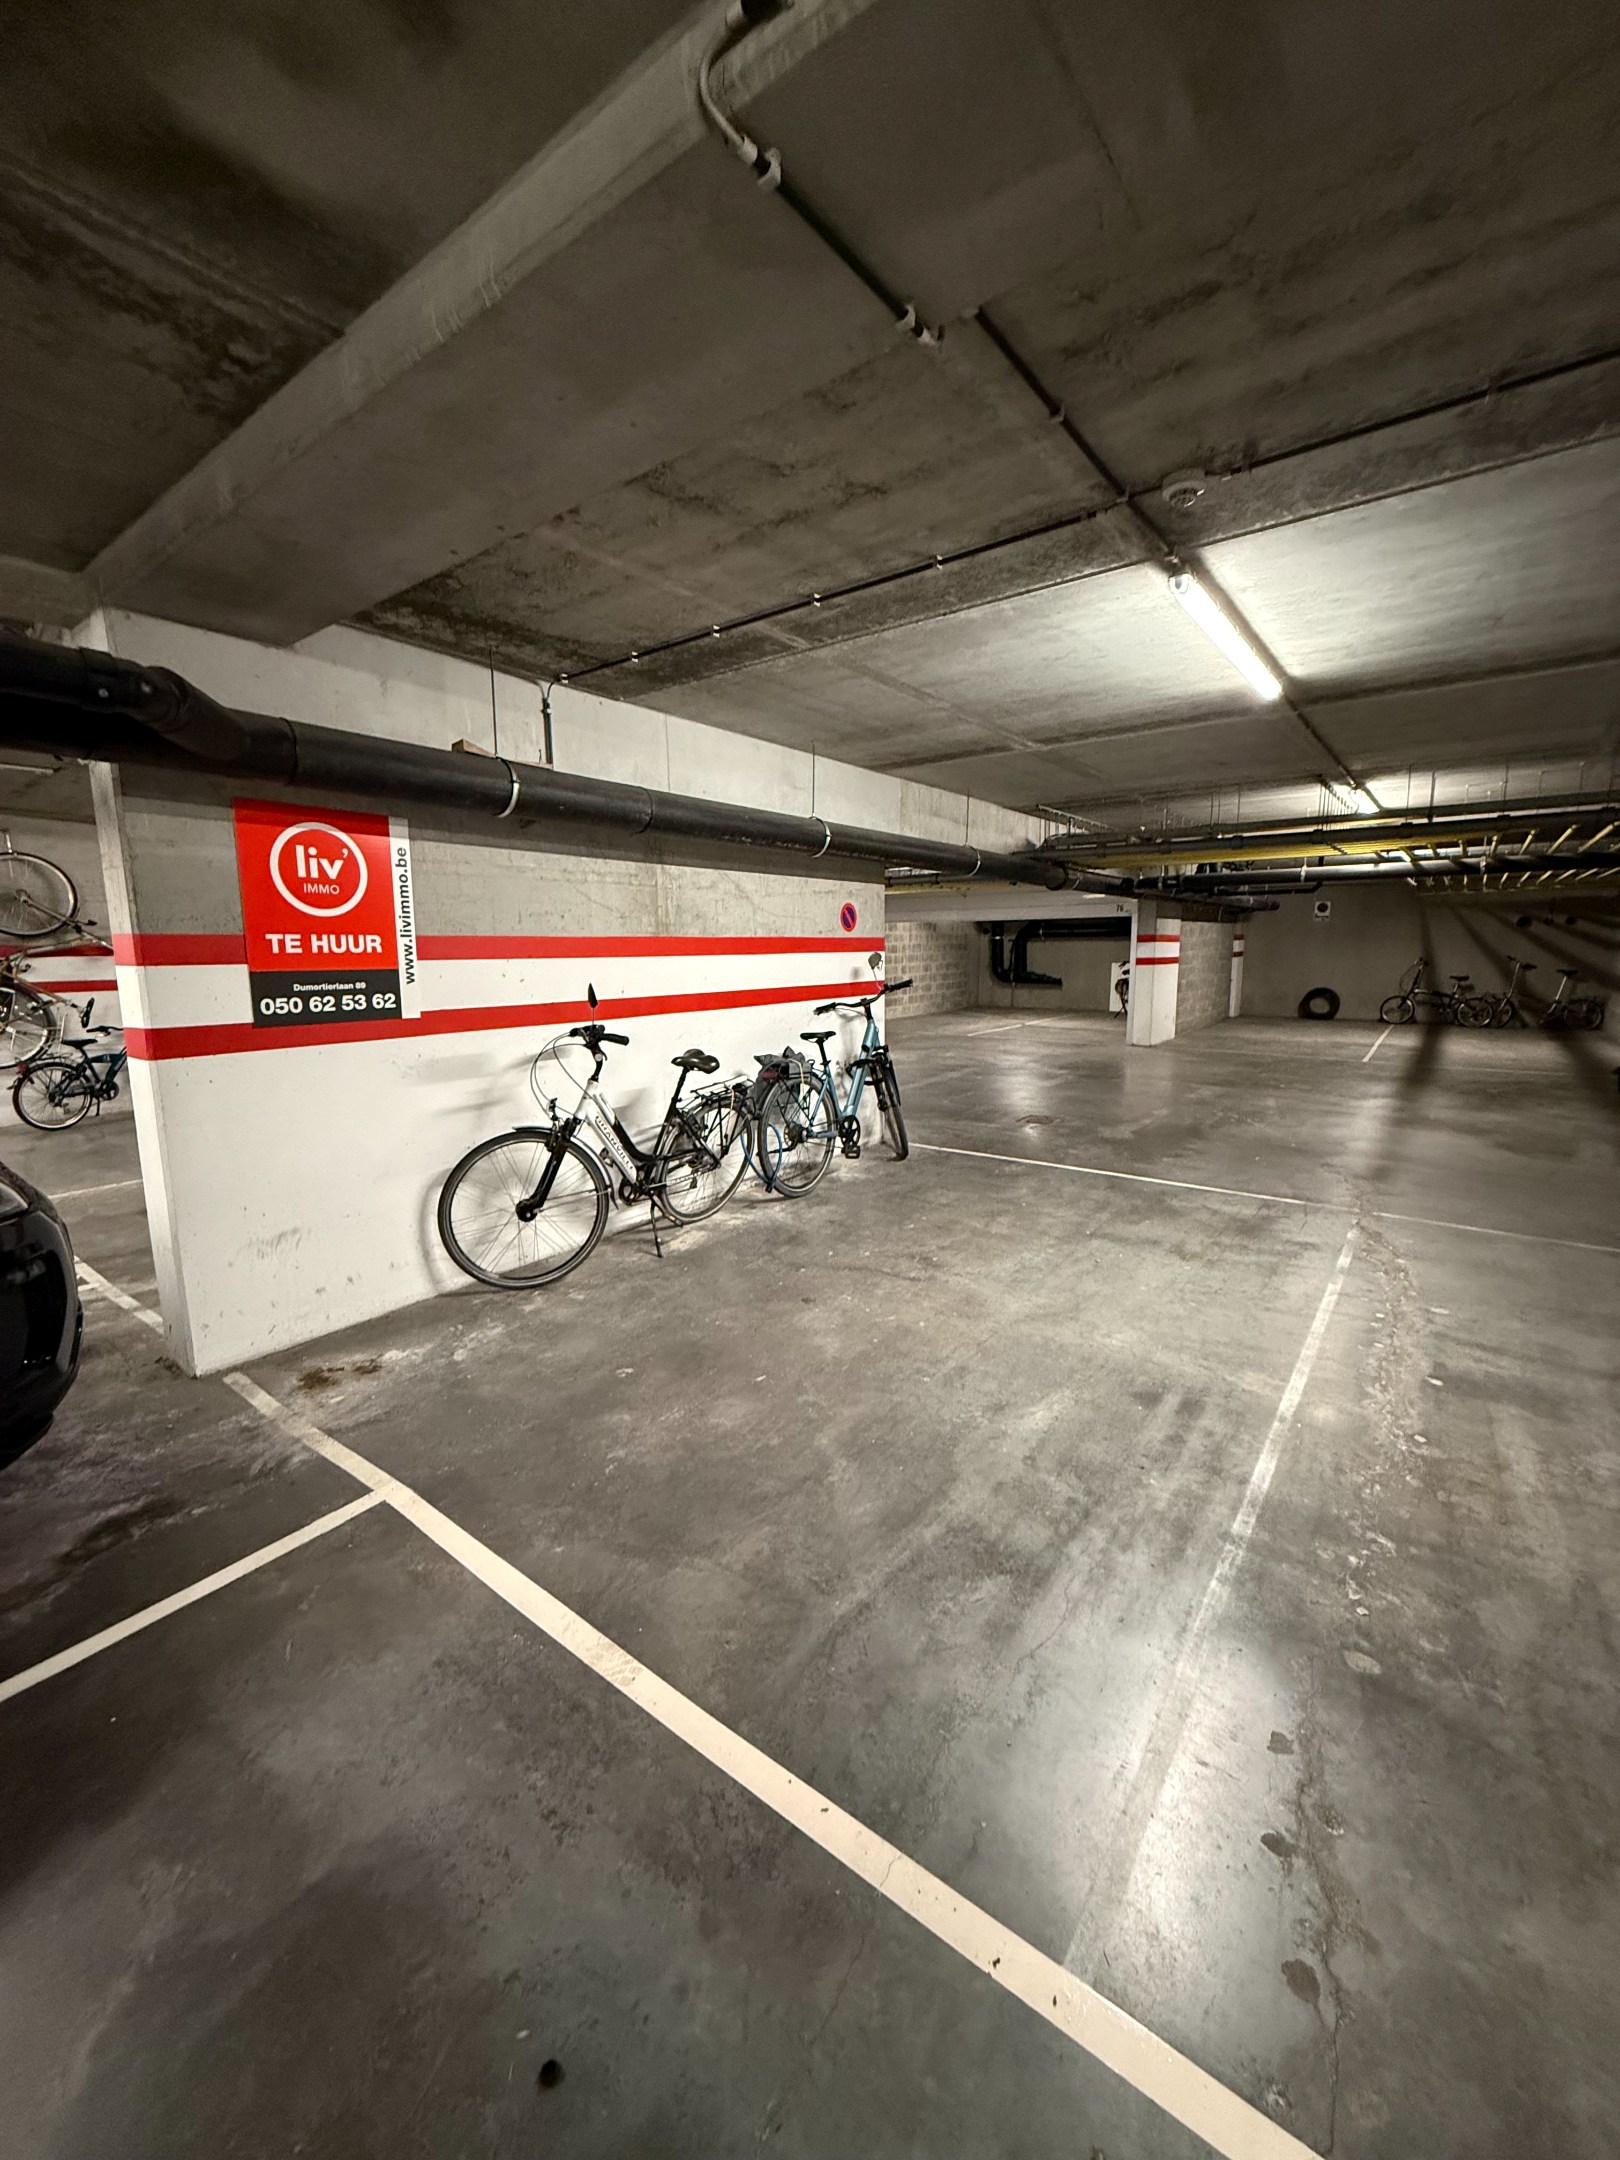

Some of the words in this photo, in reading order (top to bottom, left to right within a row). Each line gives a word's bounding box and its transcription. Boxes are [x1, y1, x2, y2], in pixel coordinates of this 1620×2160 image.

[303, 883, 340, 895] IMMO
[395, 847, 416, 985] www.livimmo.be
[265, 933, 303, 954] TE
[311, 934, 383, 954] HUUR
[293, 983, 354, 992] Dumortierlaan
[260, 997, 303, 1015] 050
[309, 996, 336, 1012] 62
[341, 994, 367, 1010] 53
[372, 993, 397, 1009] 62
